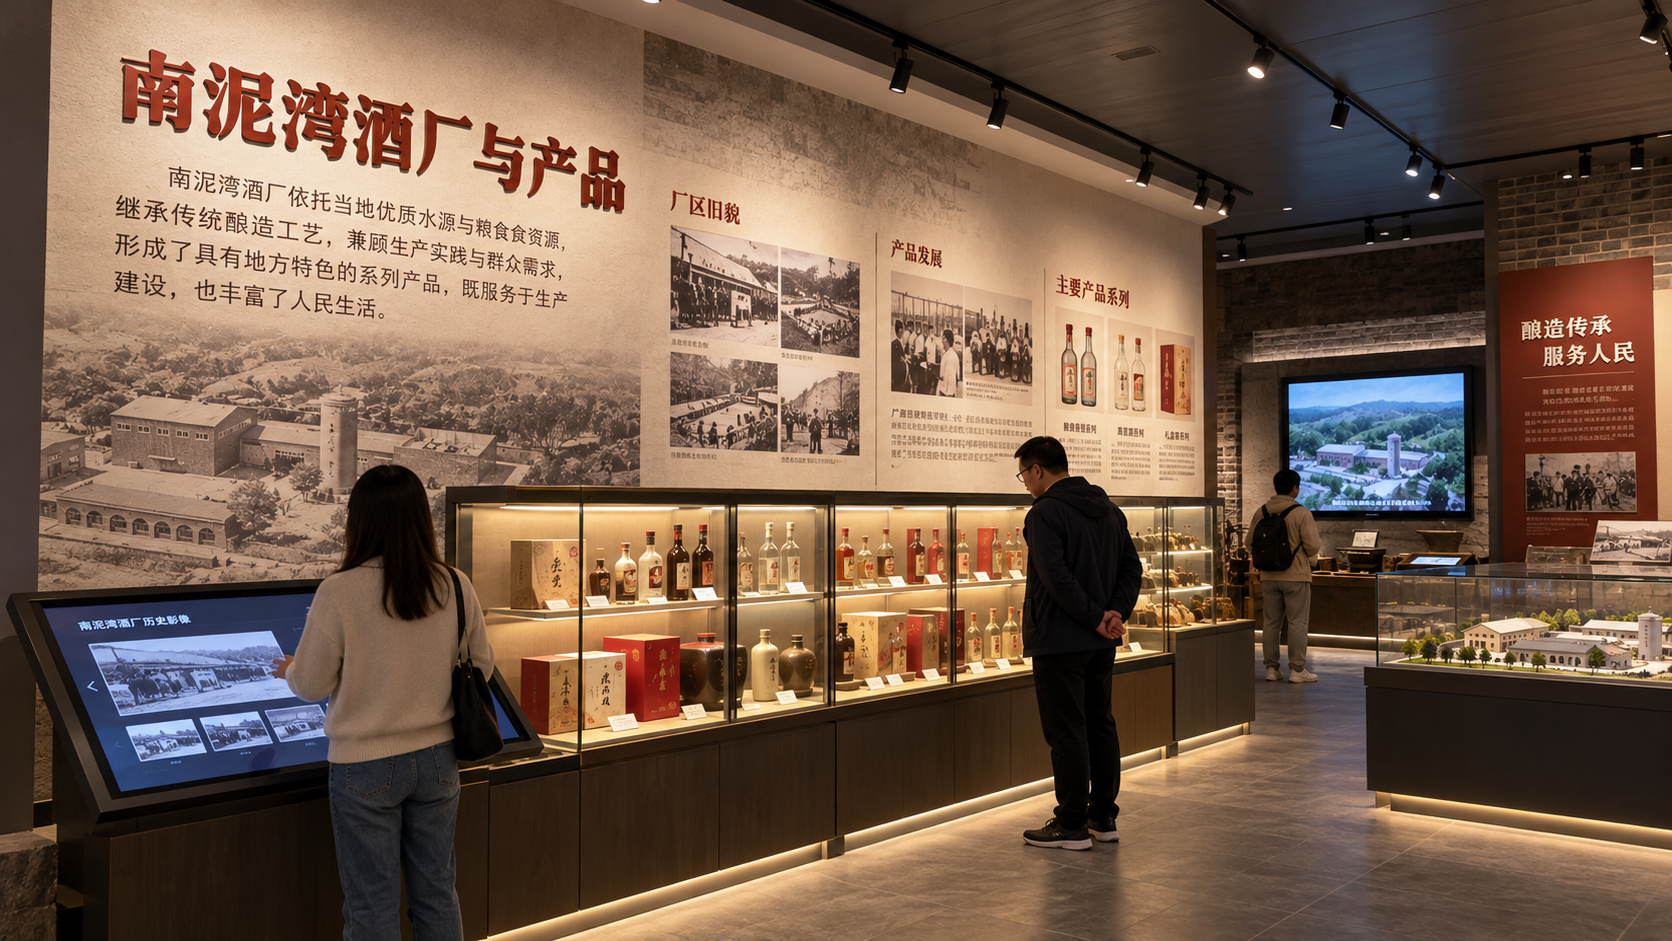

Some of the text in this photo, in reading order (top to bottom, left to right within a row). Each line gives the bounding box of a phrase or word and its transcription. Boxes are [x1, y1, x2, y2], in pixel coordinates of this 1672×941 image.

[120, 49, 626, 212] 南泥湾酒厂与产品
[670, 190, 741, 225] 厂区旧貌
[115, 194, 563, 281] 继承传统酿造工艺，兼顾生产实践与群众需求，
[890, 239, 943, 269] 产品发展
[115, 233, 568, 309] 形成了具有地方特色的系列产品，既服务于生产
[114, 270, 386, 320] 建设，也丰富了人民生活。
[1055, 274, 1130, 309] 主要产品系列
[1520, 314, 1613, 342] 酿造传承
[1543, 341, 1636, 367] 服务人民
[77, 614, 192, 632] 南泥湾酒厂历史影像
